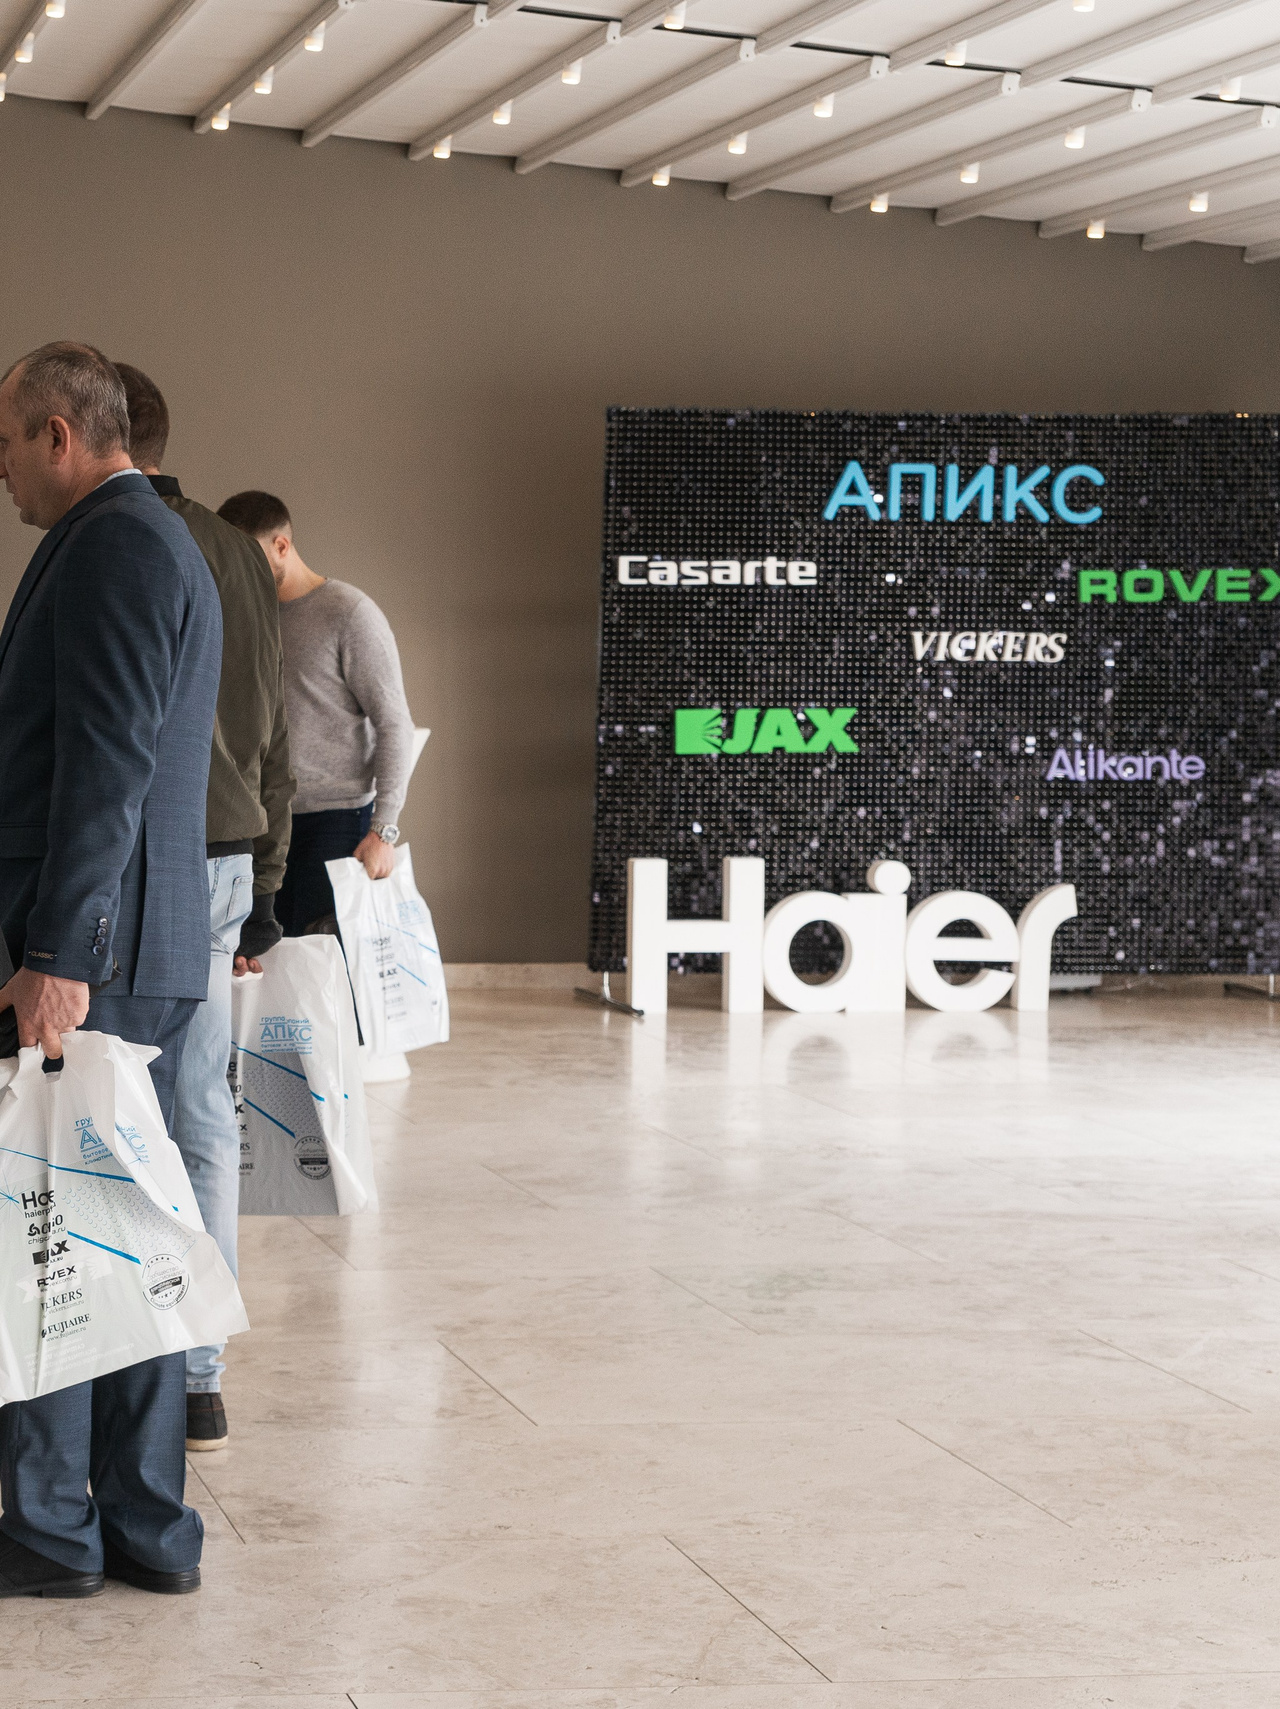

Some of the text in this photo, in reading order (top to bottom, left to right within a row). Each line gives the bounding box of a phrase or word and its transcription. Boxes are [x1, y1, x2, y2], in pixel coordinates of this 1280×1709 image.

[823, 460, 1105, 524] АПИКС
[618, 555, 819, 587] Casarte
[1078, 567, 1280, 604] ROVEX
[911, 630, 1068, 663] VICKERS
[1046, 748, 1207, 783] Alikante
[626, 857, 1079, 1015] Haier
[47, 1313, 92, 1334] FUJIAIRE
